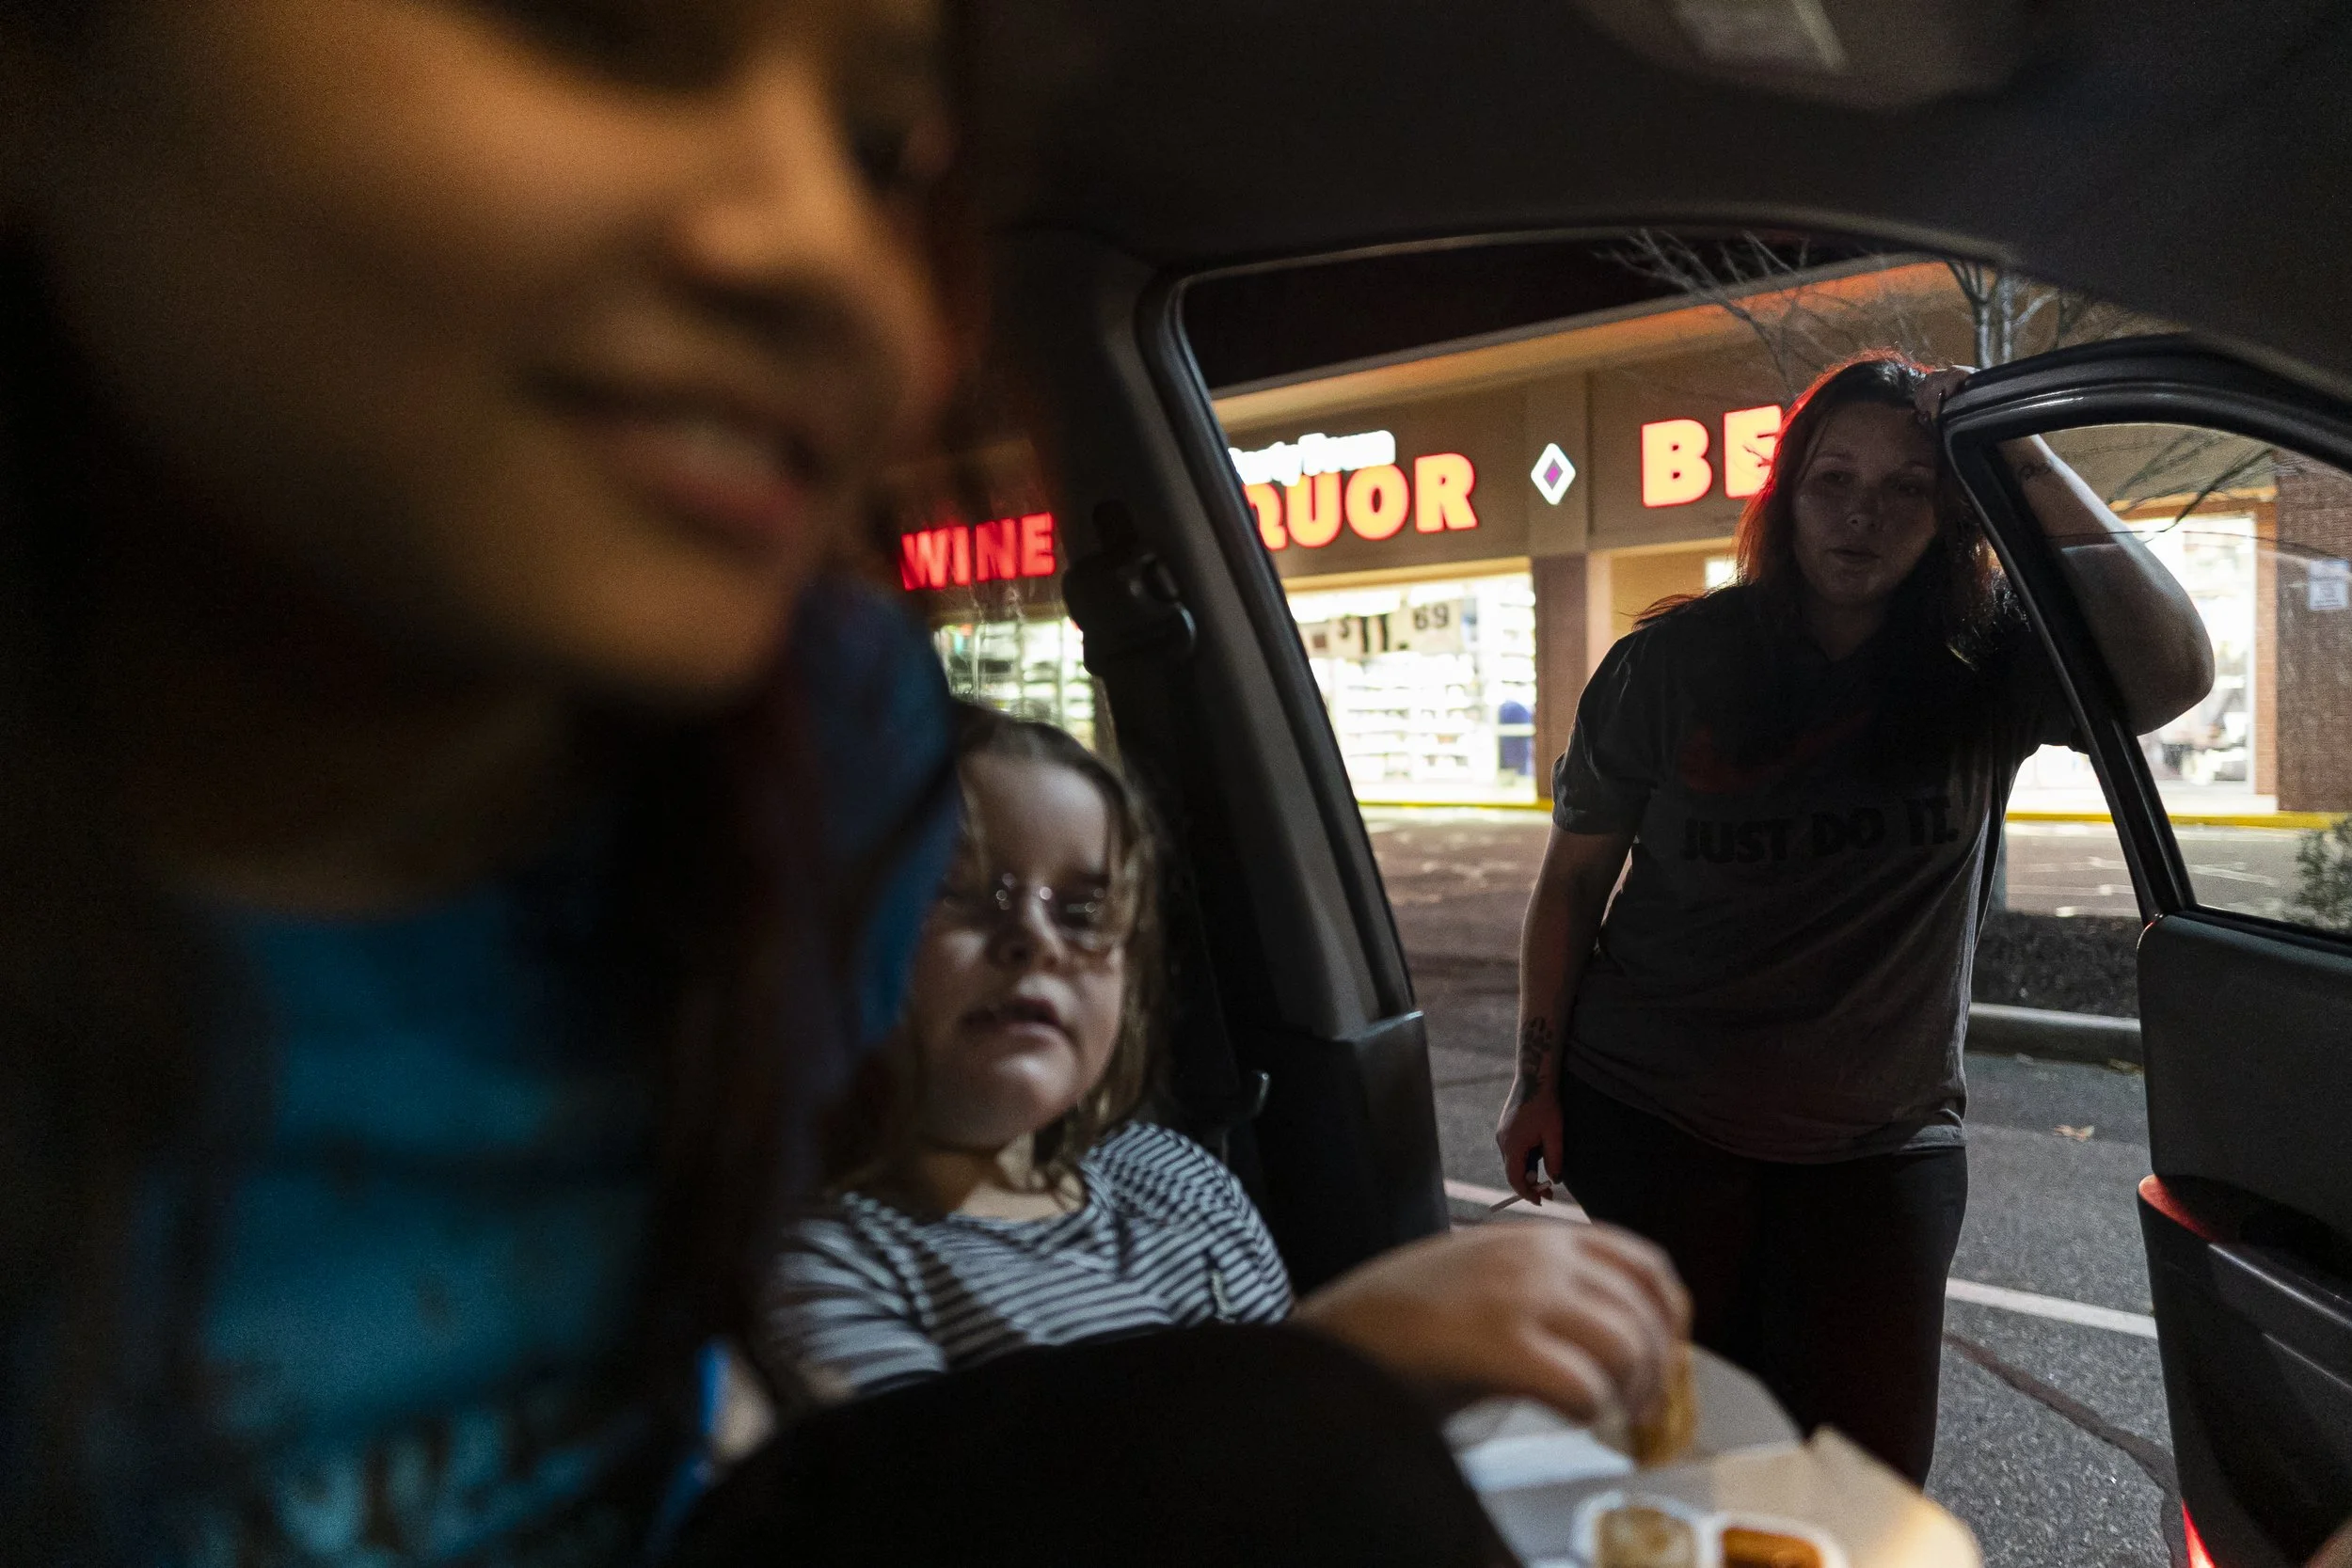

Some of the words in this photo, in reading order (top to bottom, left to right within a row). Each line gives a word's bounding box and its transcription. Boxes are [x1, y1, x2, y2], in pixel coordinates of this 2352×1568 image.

[900, 512, 1057, 591] WINE
[1680, 816, 1794, 863] JUST
[1811, 806, 1886, 857] DO
